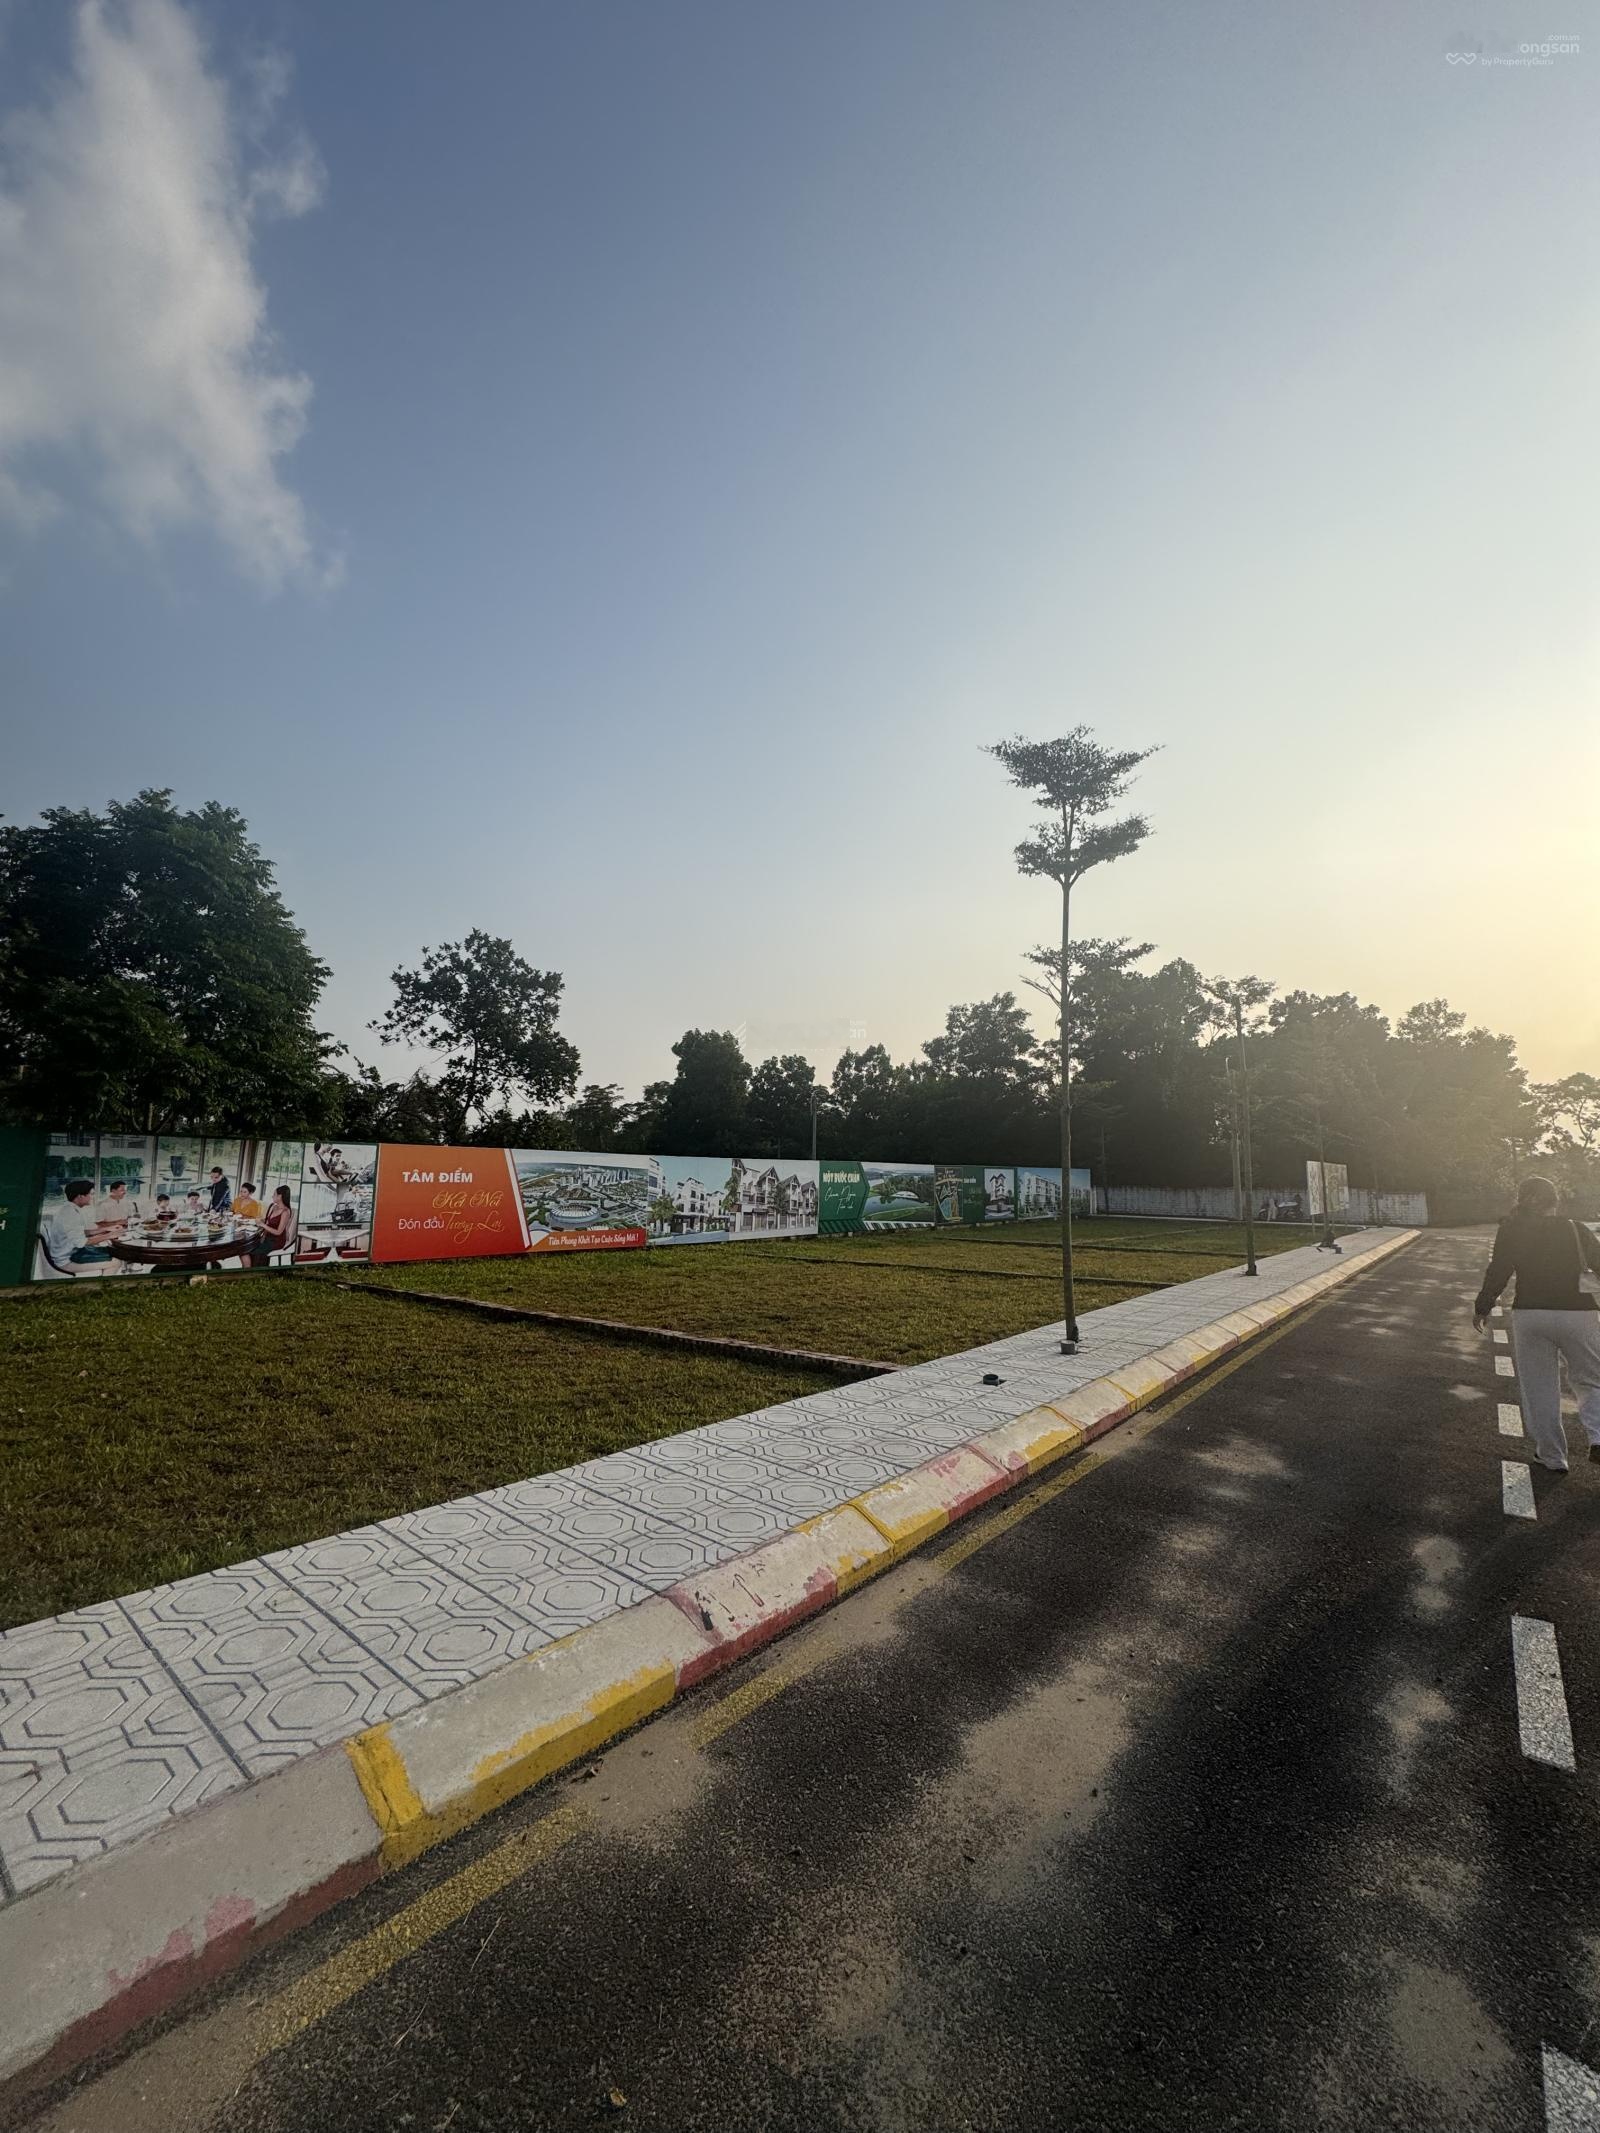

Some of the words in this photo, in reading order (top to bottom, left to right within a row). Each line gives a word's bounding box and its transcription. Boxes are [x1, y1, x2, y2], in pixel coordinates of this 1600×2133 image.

[402, 1169, 434, 1183] TÂM
[438, 1167, 473, 1183] ĐIỂM
[398, 1218, 421, 1230] Đón
[423, 1216, 445, 1229] đầu
